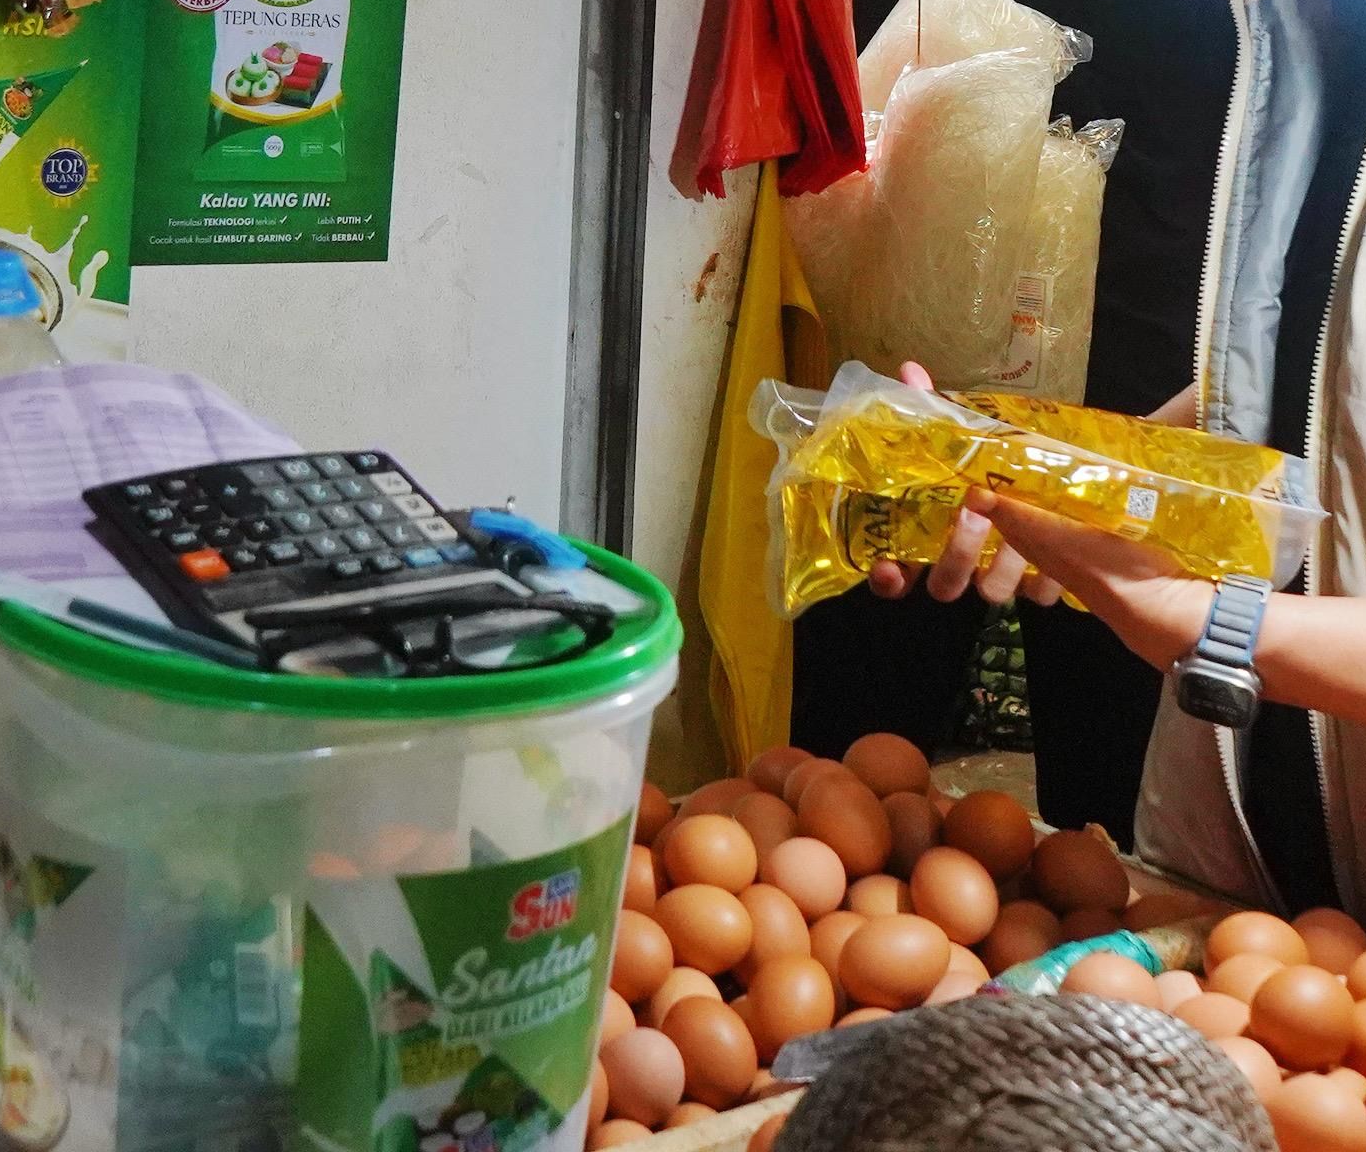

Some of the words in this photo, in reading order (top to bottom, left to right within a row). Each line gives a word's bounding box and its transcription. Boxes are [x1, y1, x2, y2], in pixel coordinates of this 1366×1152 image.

[222, 9, 288, 28] TEPUNG
[290, 12, 342, 30] BERAS
[46, 157, 84, 175] TOP
[45, 172, 85, 185] BRAND
[199, 192, 248, 210] Kalau
[252, 192, 299, 209] YANG
[301, 192, 332, 209] INI:
[203, 217, 255, 227] TEKNOLOGI
[336, 215, 362, 226] PUTIH
[213, 233, 248, 244] LEMBUT
[256, 232, 293, 244] GARING
[331, 232, 365, 243] BERBAU
[506, 880, 577, 942] SUN
[442, 931, 598, 1006] Santan
